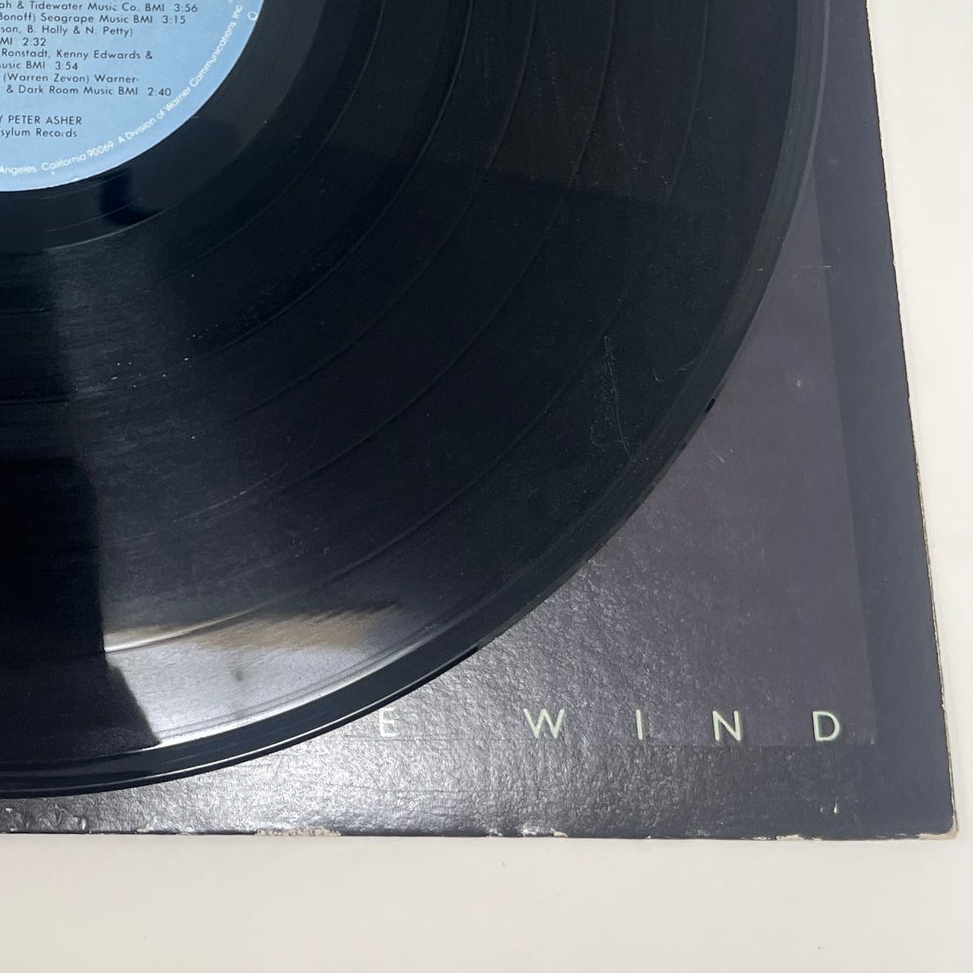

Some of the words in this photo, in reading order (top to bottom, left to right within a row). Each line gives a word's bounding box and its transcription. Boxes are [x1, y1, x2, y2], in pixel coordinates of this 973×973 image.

[17, 1, 24, 9] &
[30, 1, 83, 11] Tidewater
[87, 3, 117, 11] Music
[122, 3, 139, 12] Co.
[145, 3, 165, 12] BMI
[174, 3, 198, 13] 3:56
[40, 14, 94, 25] Seagrape
[99, 15, 128, 24] Music
[133, 15, 153, 24] BMI
[162, 15, 186, 24] 3:15
[27, 25, 36, 34] B.
[42, 25, 68, 36] Holly
[73, 26, 80, 34] &
[103, 26, 133, 38] Petty)
[2, 49, 51, 58] Ronstadt,
[56, 49, 89, 60] Kenny
[93, 50, 141, 60] Edwards
[145, 51, 153, 59] &
[26, 61, 45, 70] BMI
[3, 72, 49, 82] (Warren
[53, 73, 90, 83] Zevon)
[94, 74, 139, 83] Warner-
[6, 85, 13, 93] &
[18, 85, 44, 94] Dark
[49, 86, 79, 95] Room
[83, 87, 113, 95] Music
[118, 87, 138, 95] BMI
[147, 87, 171, 97] 2:40
[8, 115, 40, 124] PETER
[46, 116, 82, 125] ASHER
[524, 708, 842, 742] WIND
